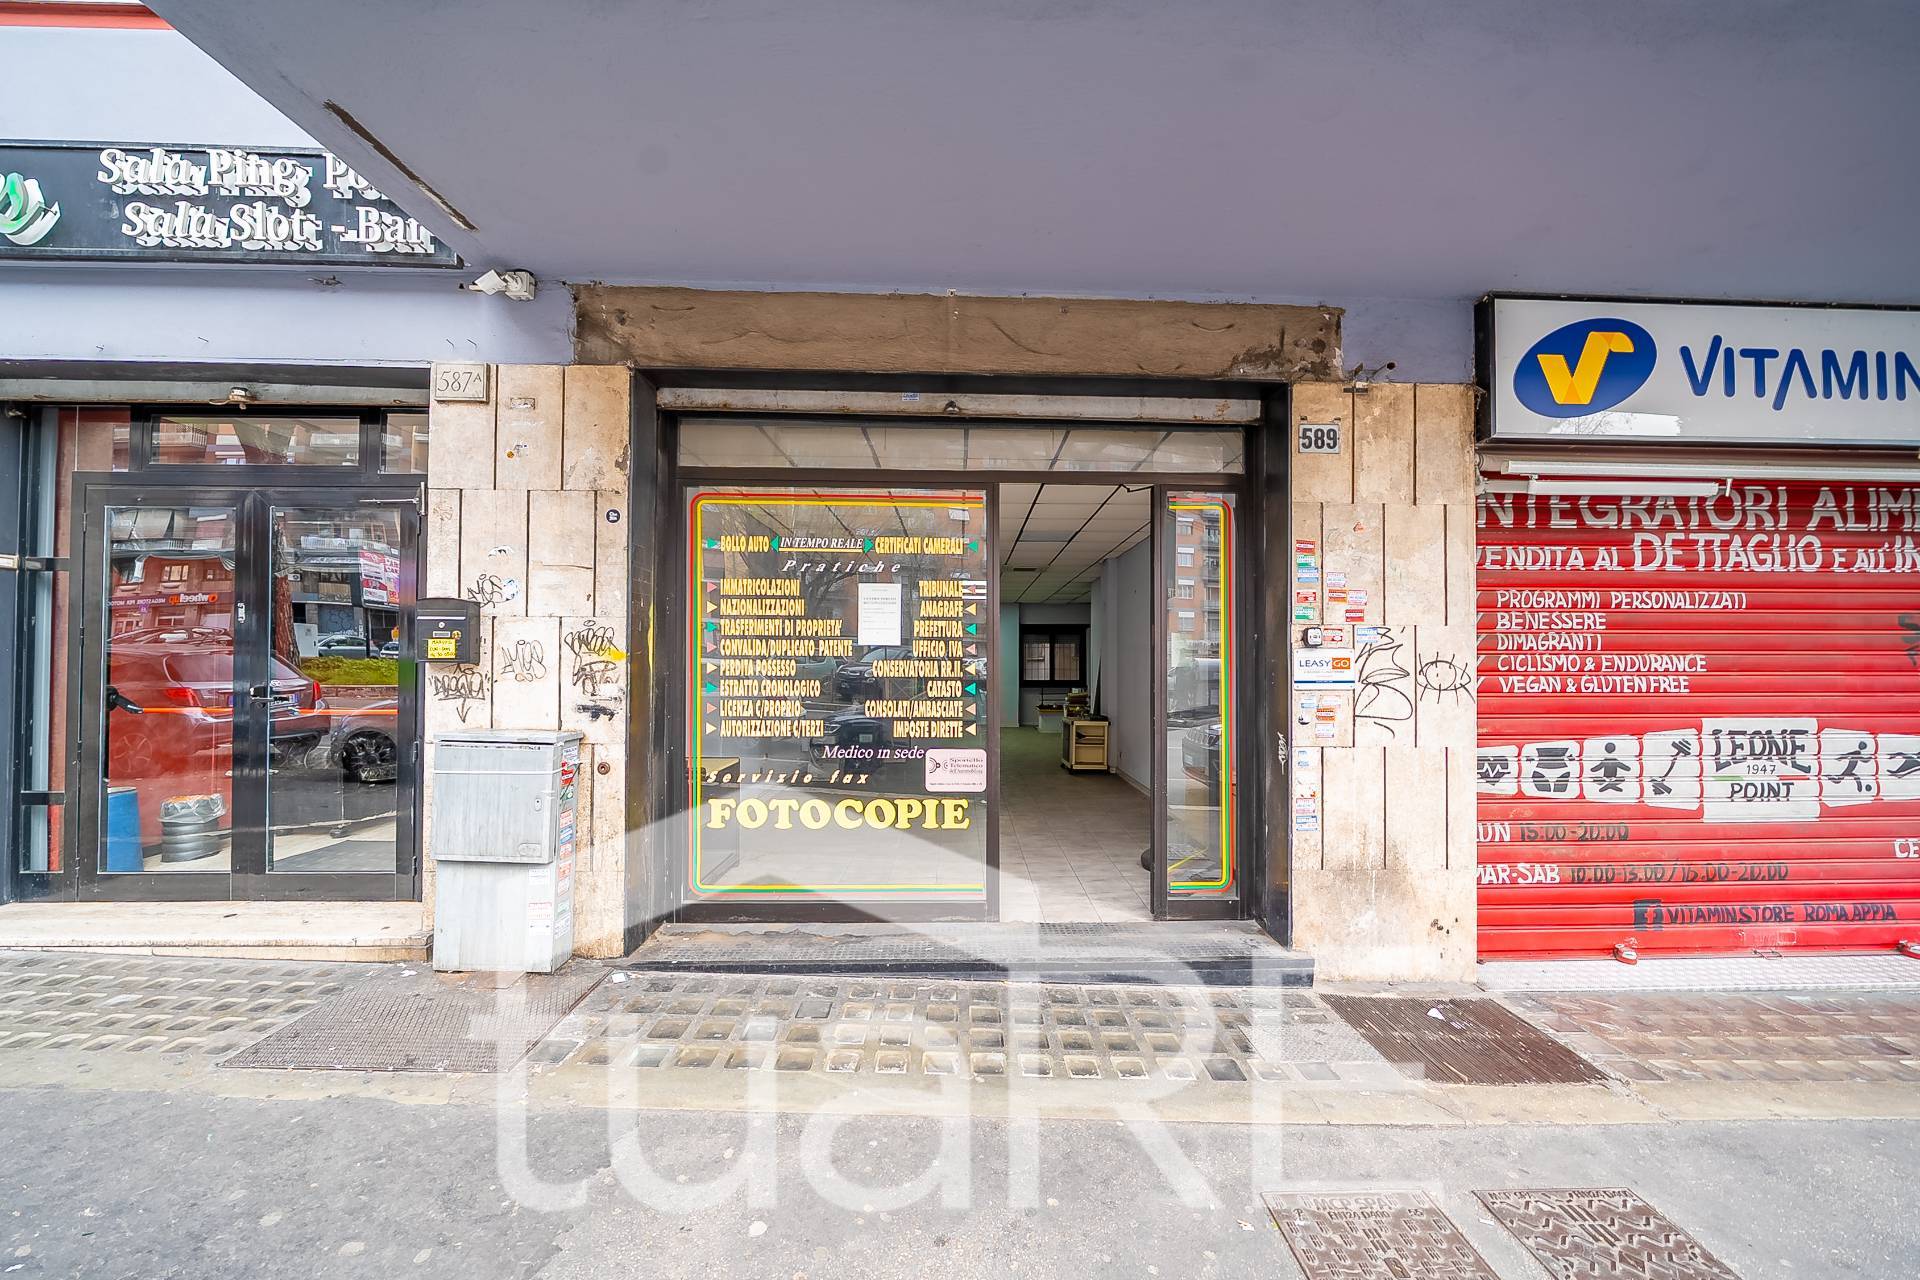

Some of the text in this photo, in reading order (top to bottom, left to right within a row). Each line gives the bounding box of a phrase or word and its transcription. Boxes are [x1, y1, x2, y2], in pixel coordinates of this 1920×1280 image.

[98, 148, 200, 186] Sala
[205, 149, 303, 198] Ping
[122, 201, 216, 240] Sala
[229, 201, 310, 243] Slot
[1300, 427, 1338, 450] 589
[720, 536, 769, 553] BOLLO AUTO
[780, 537, 863, 549] IN TEMPO REALE
[875, 536, 963, 554] CERTIFICATI CAMERALI
[1594, 546, 1625, 571] AL
[1633, 532, 1823, 572] DETTAGLIO
[1832, 548, 1849, 572] E
[781, 559, 901, 573] Pratiche
[720, 578, 800, 596] IMMATRICOLAZIONI
[918, 580, 963, 597] TRIBUNALE
[720, 598, 805, 616] NAZIONALIZZAZIONI
[920, 600, 963, 617] ANAGRAFE
[1496, 590, 1747, 610] PROGRAMMI PERSONALIZZATI
[720, 619, 783, 637] TRASFERIMENTI
[784, 619, 794, 636] DI
[913, 620, 963, 638] PREFETTURA
[1496, 611, 1607, 630] BENESSERE
[818, 639, 853, 657] PATENTE
[912, 640, 963, 658] UFFICIO IVA
[1496, 632, 1603, 651] DIMAGRANTI
[720, 659, 797, 677] PERDITA POSSESSO
[872, 659, 939, 678] CONSERVATORIA
[1497, 654, 1708, 673] CICLISMO & ENDURANCE
[720, 679, 820, 697] ESTRATTO CRONOLOGICO
[927, 680, 962, 697] CATASTO
[1499, 675, 1561, 694] VEGAN
[1566, 677, 1578, 693] &
[720, 699, 801, 718] LICENZA C/PROPRIO
[864, 699, 963, 719] CONSOLATI/AMBASCIATE
[720, 719, 825, 739] AUTORIZZAZIONE C/TERZI
[893, 720, 963, 738] IMPOSTE DIRETTE
[822, 744, 925, 759] Medico in sede
[1712, 729, 1812, 774] LEONE
[706, 769, 869, 784] Servizio fax
[1746, 764, 1777, 775] 1947
[1731, 782, 1795, 802] POINT
[706, 797, 971, 830] FOTOCOPIE
[1803, 902, 1849, 922] ROMA
[1851, 902, 1898, 922] APPIA
